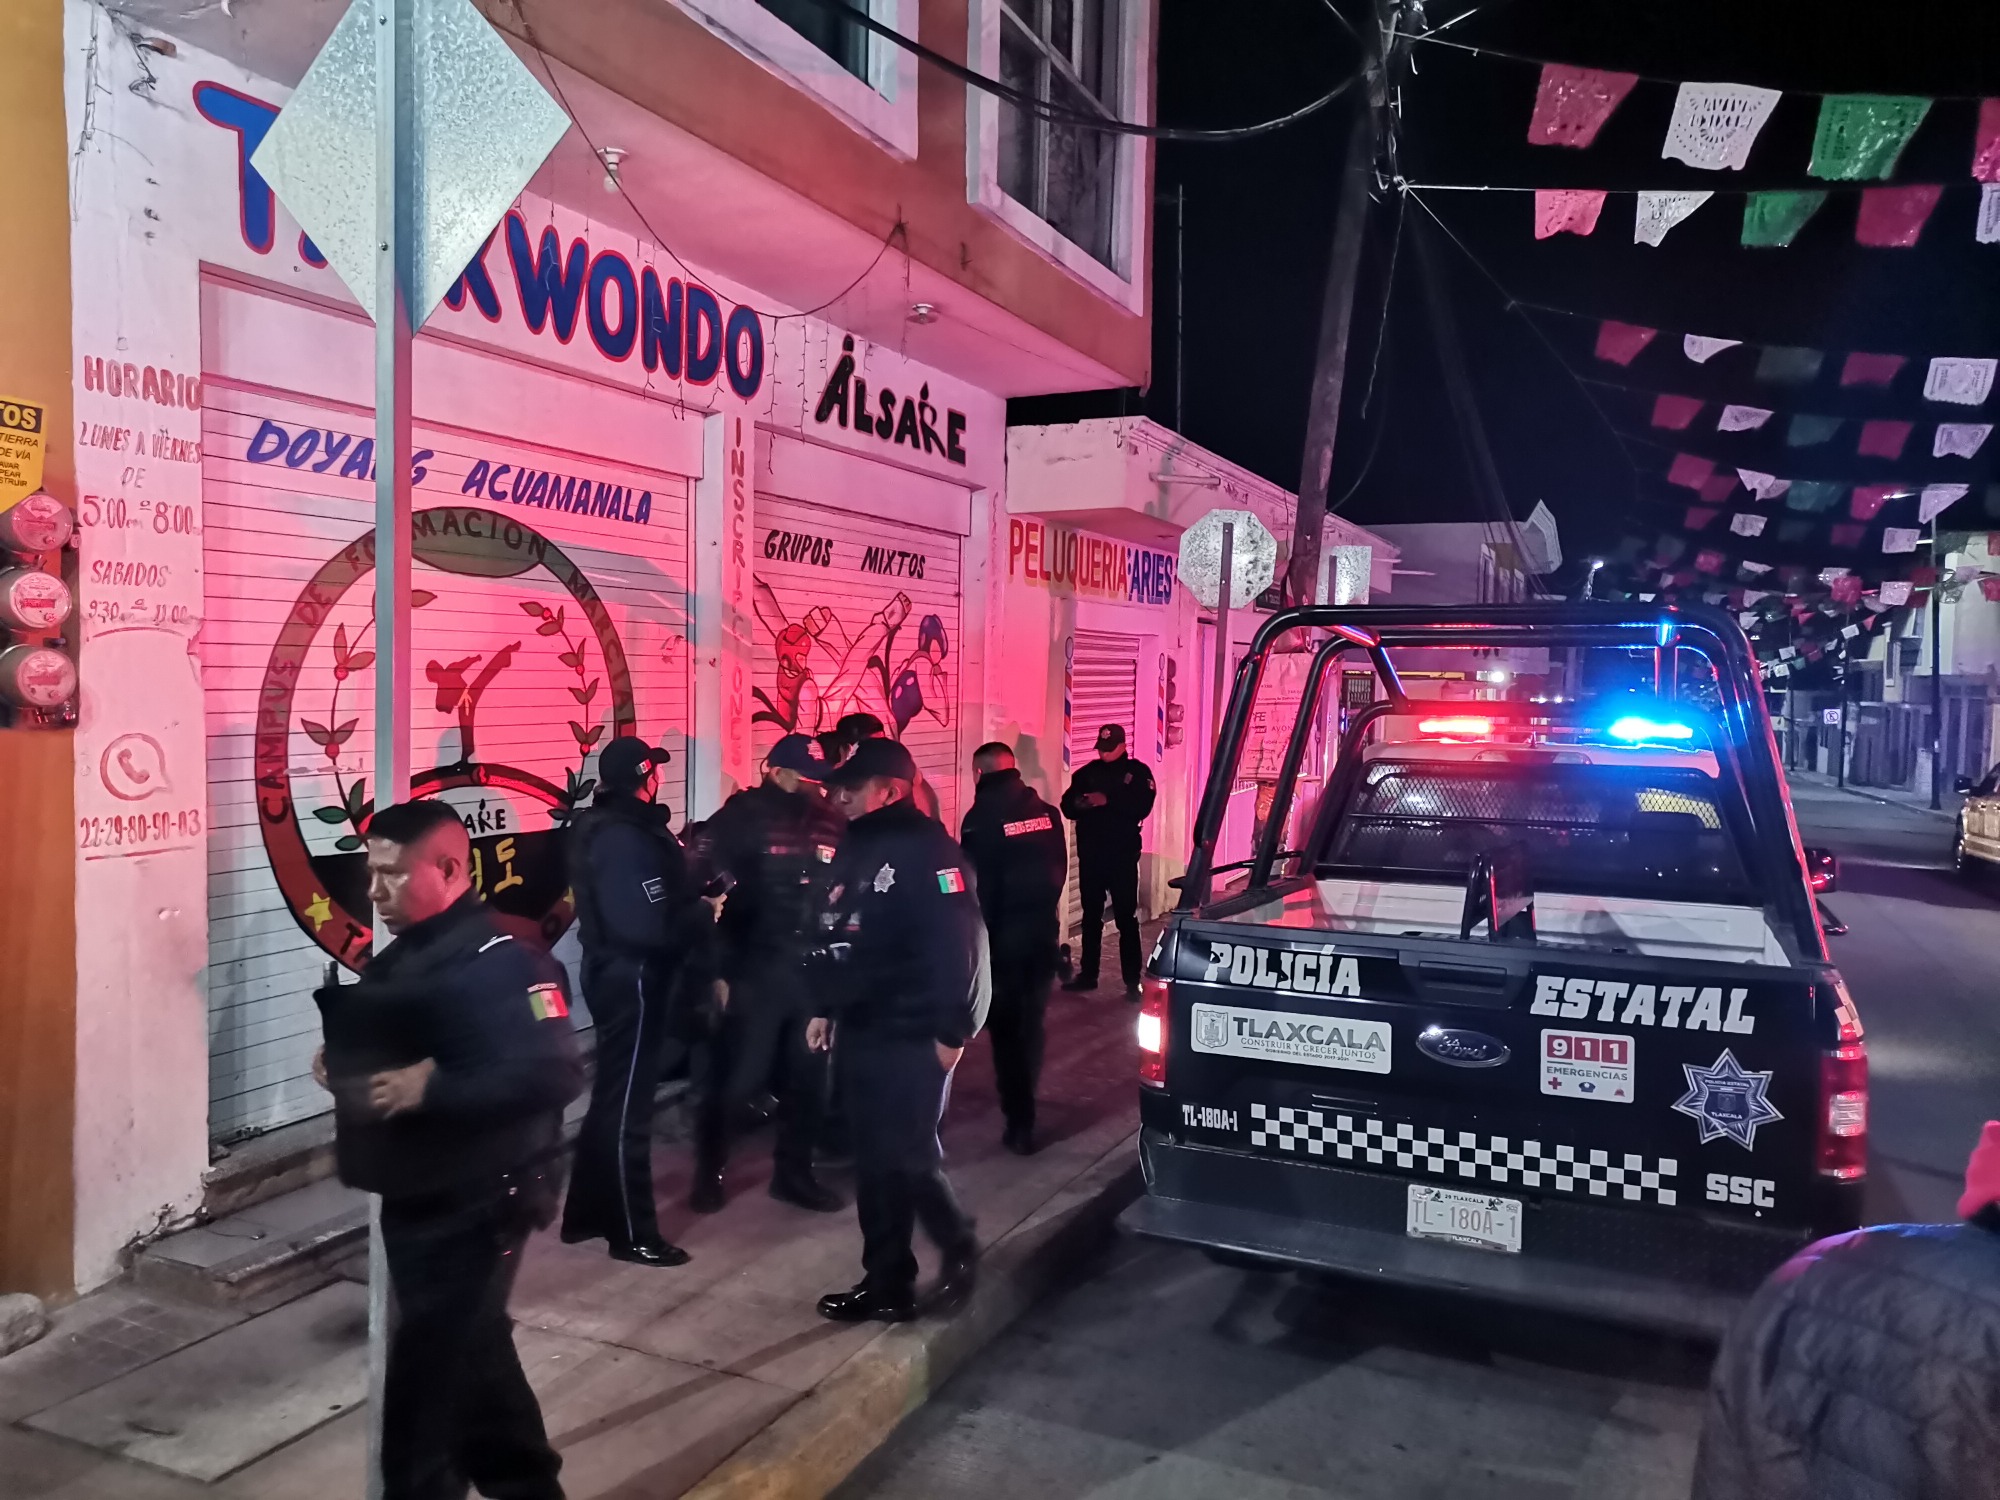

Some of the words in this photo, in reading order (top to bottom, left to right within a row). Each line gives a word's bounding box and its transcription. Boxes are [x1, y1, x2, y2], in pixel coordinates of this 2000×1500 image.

[84, 355, 201, 411] HORARIO
[0, 402, 37, 430] OS
[16, 449, 31, 460] VÍA
[79, 421, 131, 451] LUNES
[135, 431, 146, 455] A
[152, 428, 201, 464] VIERNES
[121, 467, 146, 489] DE
[461, 459, 652, 525] ACUAMANALA
[764, 529, 833, 567] GRUPOS
[861, 546, 926, 579] MIXTOS
[1009, 518, 1128, 595] PELUQUERIA
[91, 560, 170, 587] SABADOS
[258, 657, 296, 825] CAMPUS
[296, 582, 333, 628] DE
[1203, 941, 1361, 997] POLICÍA
[1530, 975, 1755, 1034] ESTATAL
[1233, 1016, 1386, 1052] TLAXCALA
[1241, 1037, 1293, 1050] CONSTRUIR
[1294, 1043, 1300, 1051] Y
[1303, 1044, 1338, 1056] CRECER
[1341, 1048, 1376, 1060] JUNTOS
[1437, 1035, 1487, 1060] Ford
[1552, 1038, 1620, 1061] 911
[1547, 1066, 1628, 1081] EMERGENCIAS
[1182, 1104, 1238, 1131] TL-180A-1
[1711, 1111, 1742, 1119] TLAXCALA
[1453, 1195, 1484, 1204] TLAXCALA
[1706, 1172, 1775, 1208] SSC
[1412, 1199, 1516, 1238] TL-180A-1
